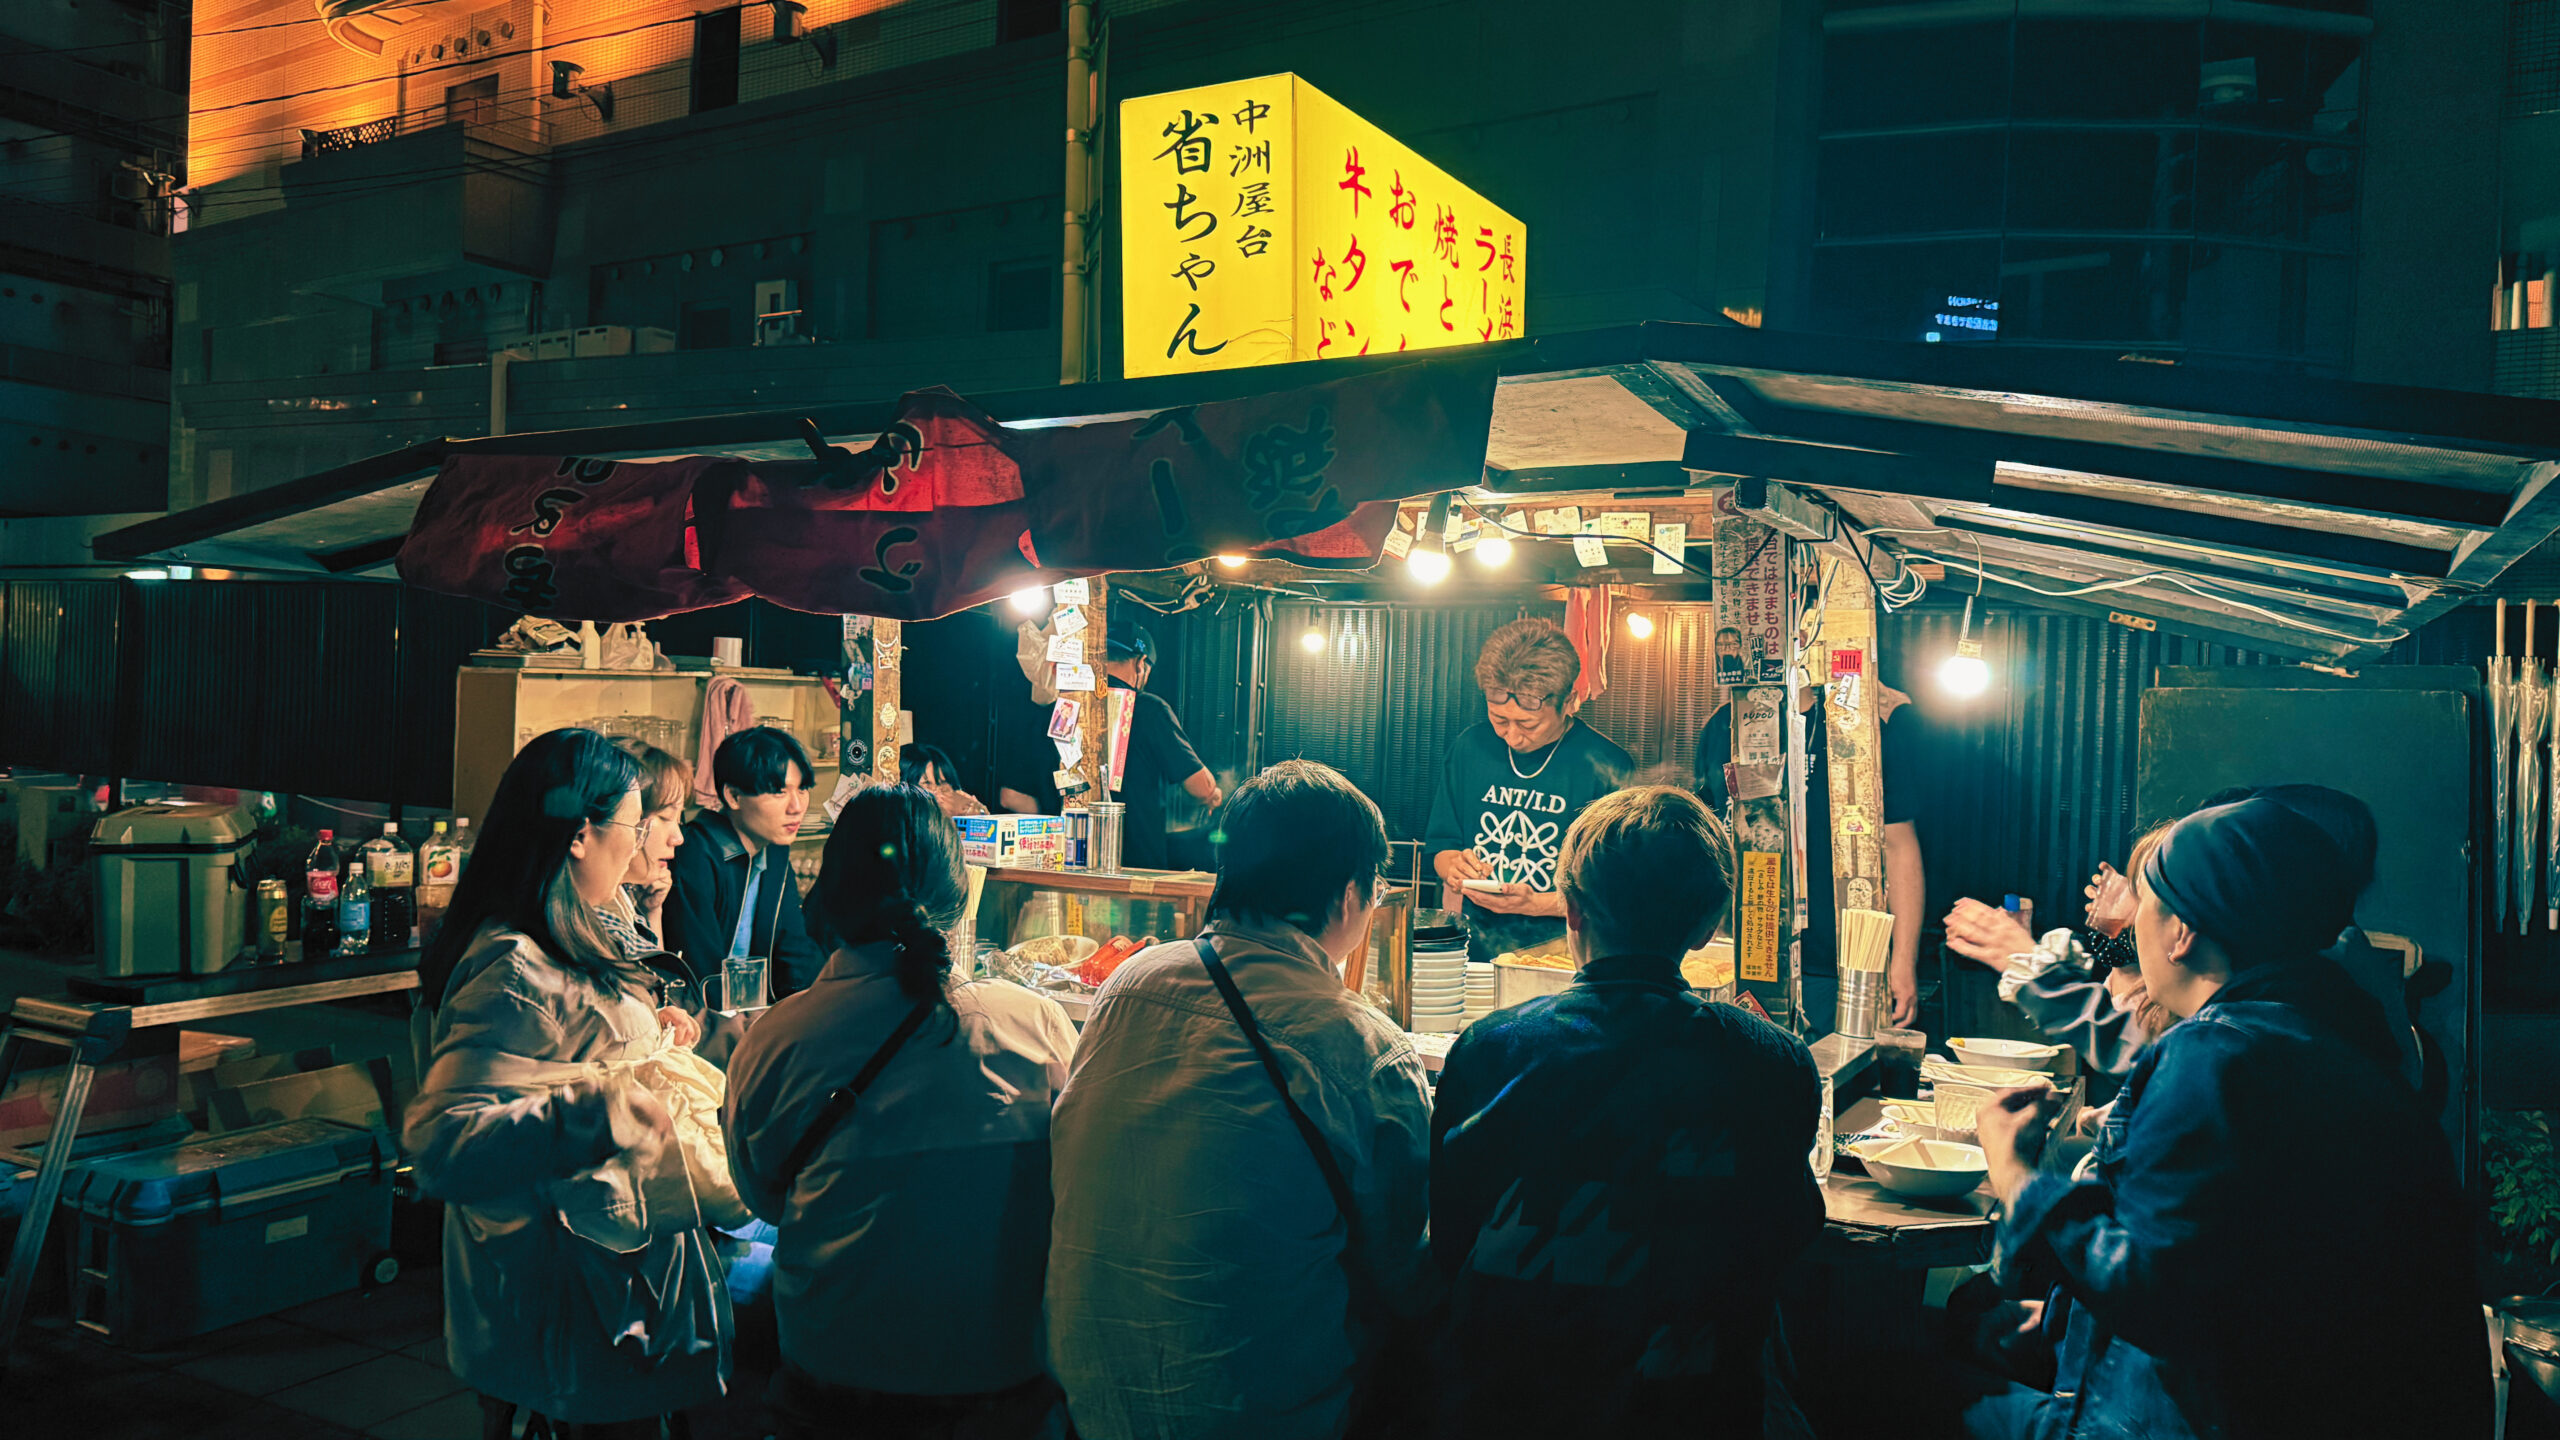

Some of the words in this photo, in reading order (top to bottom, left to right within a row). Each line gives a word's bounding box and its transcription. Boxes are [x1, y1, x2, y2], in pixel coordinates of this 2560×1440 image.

[1153, 109, 1228, 359] 省ちゃん
[1228, 99, 1275, 259] 中洲屋台
[1310, 246, 1338, 361] など
[1497, 234, 1516, 341] 長浜
[1763, 530, 1780, 656] 台ではなまものは
[1001, 830, 1016, 856] ド
[1481, 784, 1567, 814] ANT/I.D
[1764, 857, 1776, 978] 屋台では生ものは提供できません
